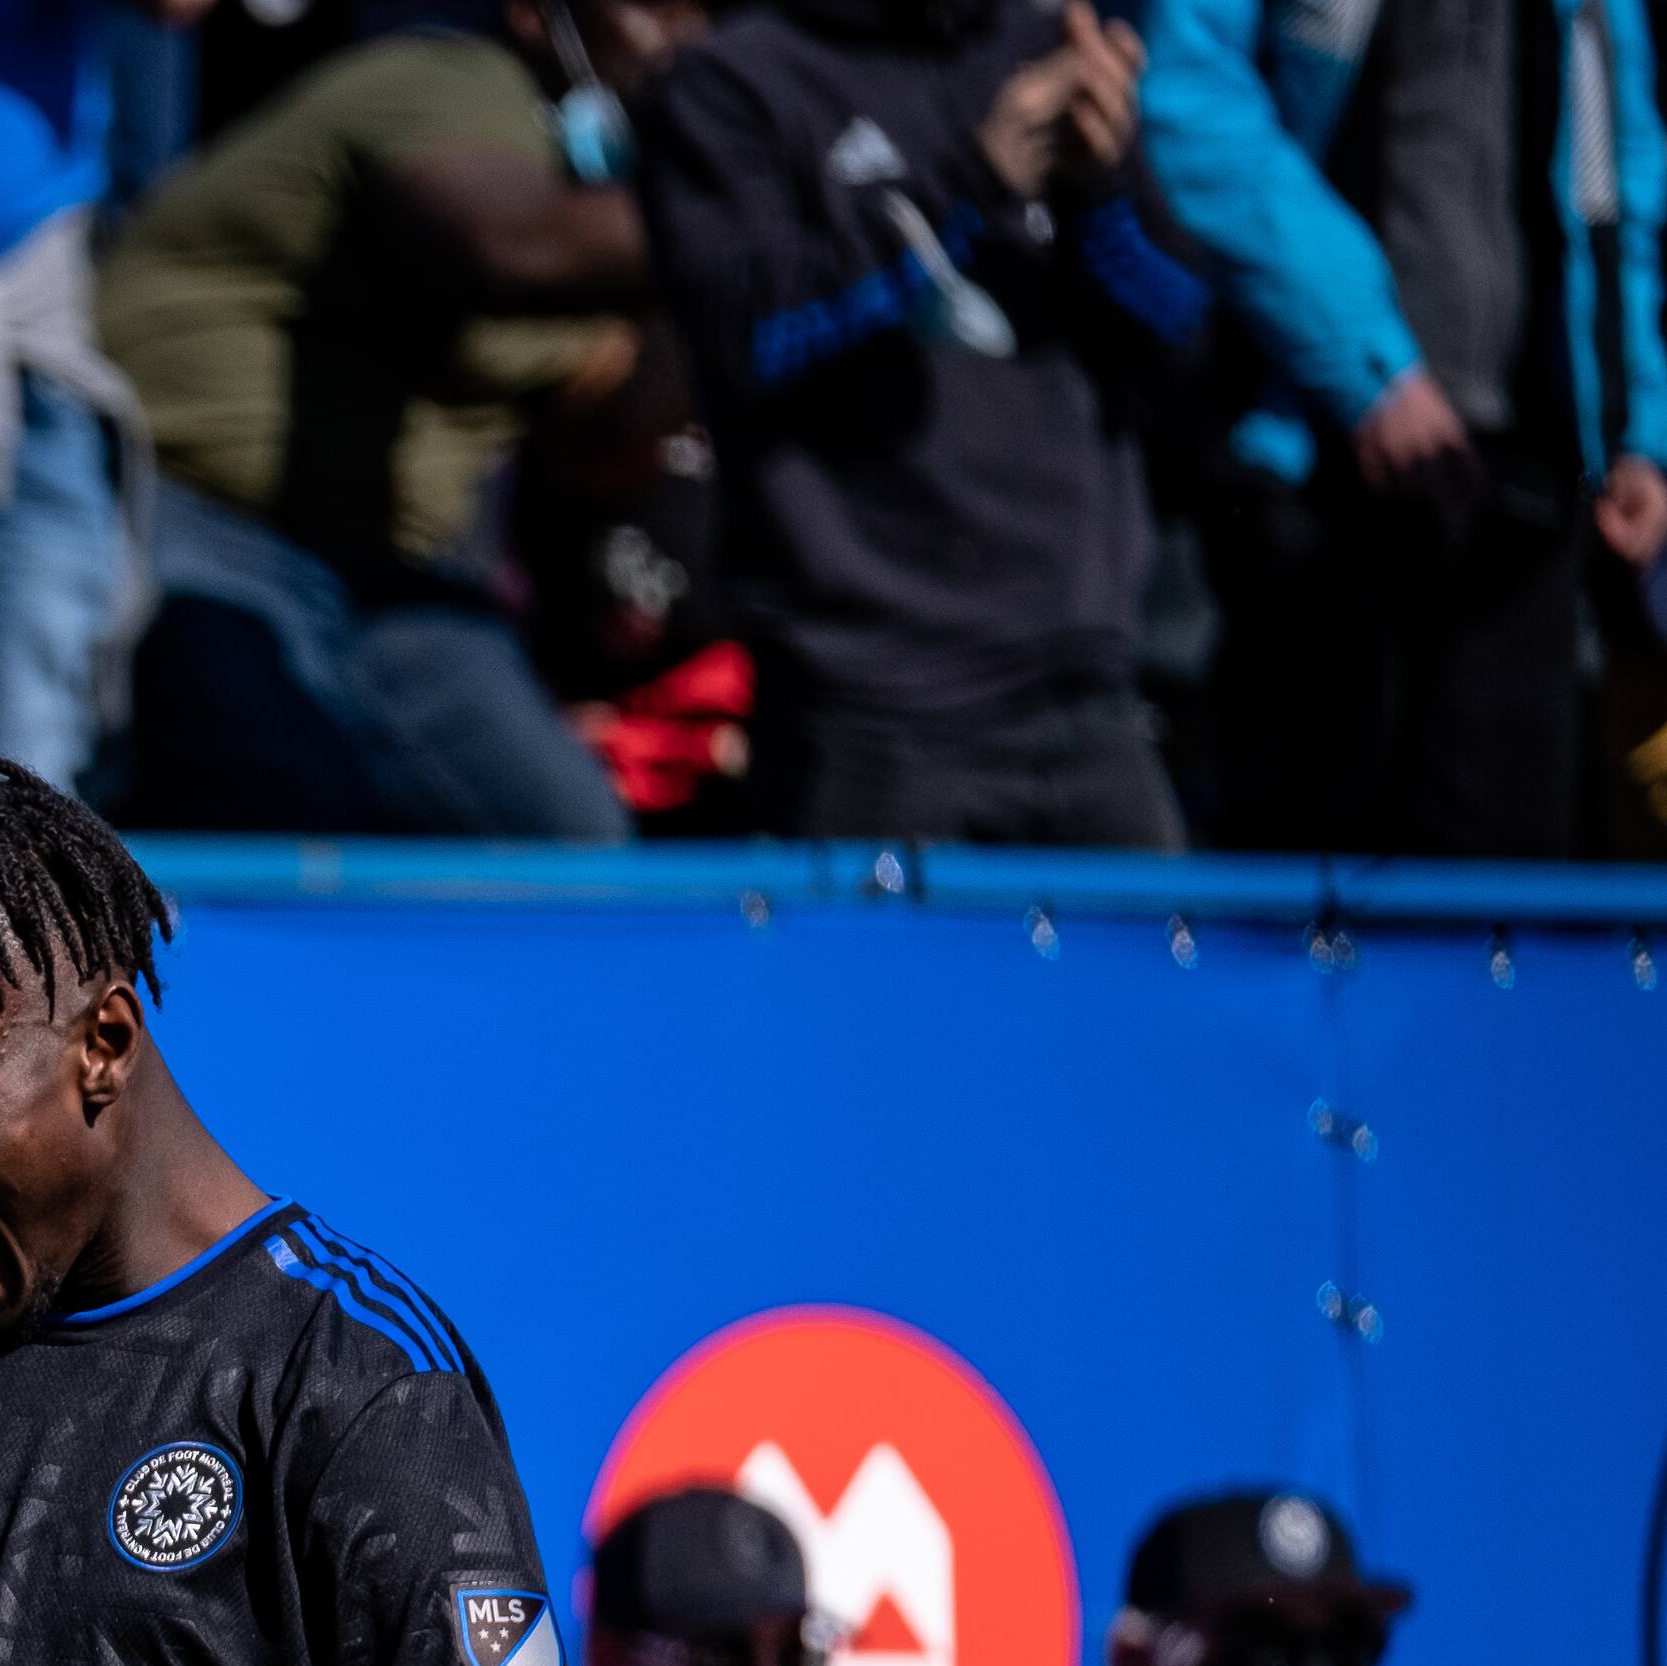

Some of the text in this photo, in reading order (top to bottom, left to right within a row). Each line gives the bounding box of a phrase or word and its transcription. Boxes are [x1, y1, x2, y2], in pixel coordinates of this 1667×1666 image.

[124, 1464, 150, 1492] CLUB
[150, 1454, 166, 1468] DE
[167, 1449, 200, 1463] FOOT
[150, 1550, 183, 1562] FOOT
[468, 1598, 526, 1624] MLS
